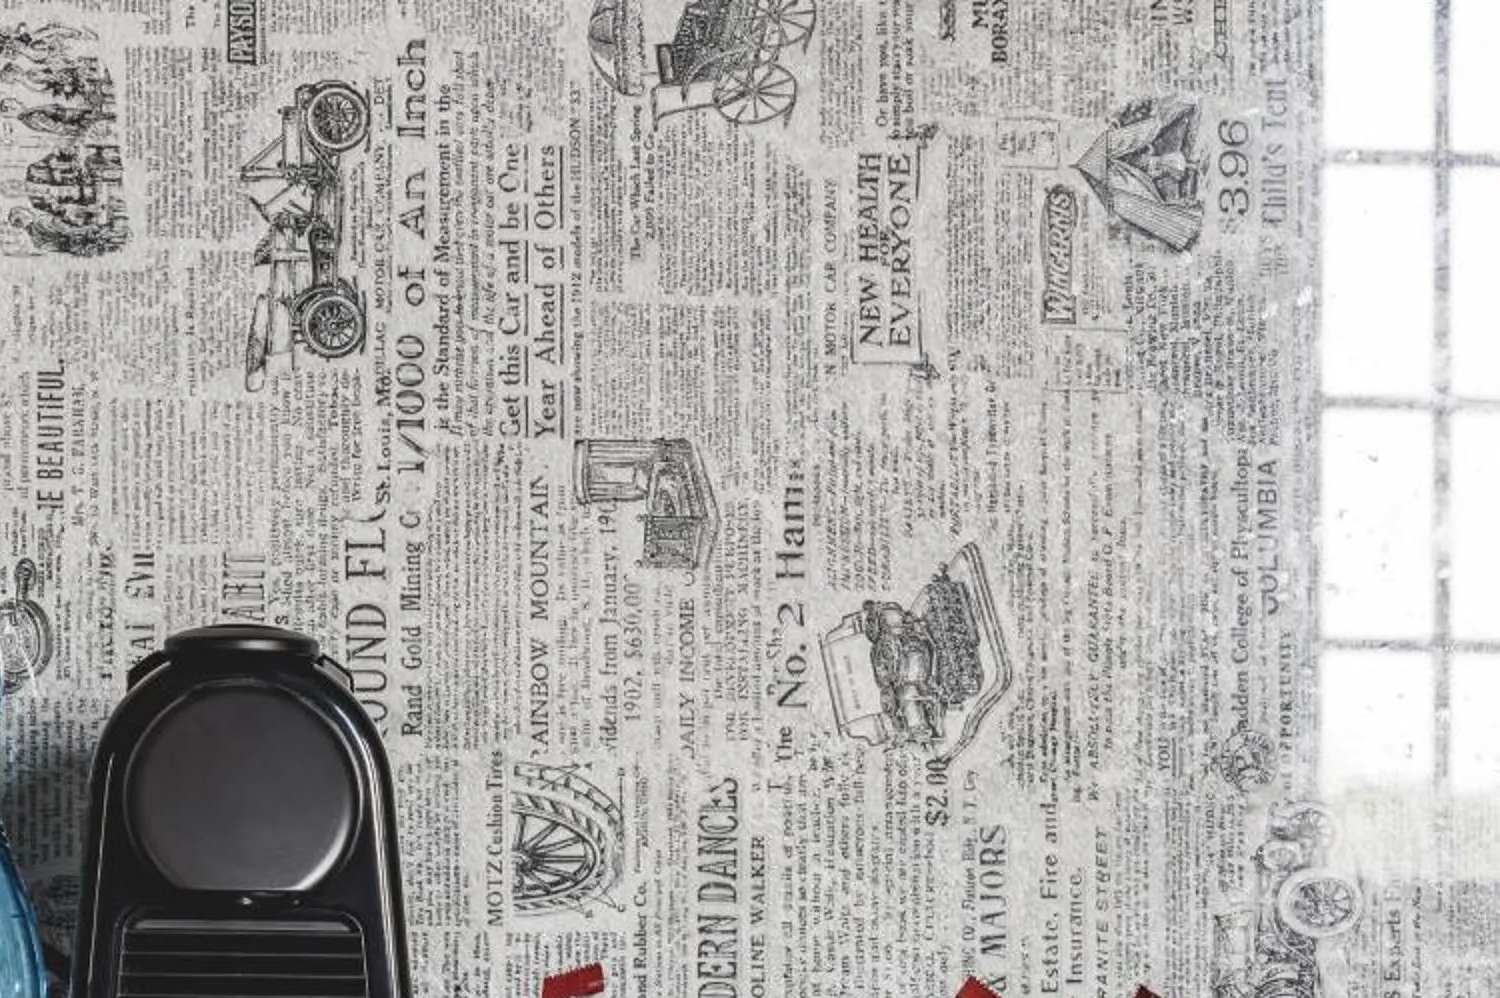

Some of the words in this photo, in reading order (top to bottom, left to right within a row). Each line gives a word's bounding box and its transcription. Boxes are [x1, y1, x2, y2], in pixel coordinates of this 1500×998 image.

[434, 143, 451, 263] Measurement
[499, 204, 521, 230] be
[536, 145, 556, 230] Others
[857, 154, 882, 262] HEALTH
[499, 241, 521, 283] and
[536, 245, 556, 270] of
[889, 155, 912, 346] EVERYONE
[397, 267, 425, 306] of
[858, 276, 882, 346] NEW
[434, 294, 450, 375] Standard
[536, 284, 556, 364] Ahead
[499, 346, 521, 386] this
[500, 396, 521, 436] Get
[536, 381, 556, 439] Year
[402, 542, 424, 611] Mining
[778, 601, 805, 626] 2
[402, 626, 422, 669] Gold
[776, 645, 806, 708] No.
[402, 685, 422, 736] Rand
[751, 837, 765, 921] WALKER
[980, 824, 1006, 958] MAJORS
[1040, 854, 1058, 899] Fire
